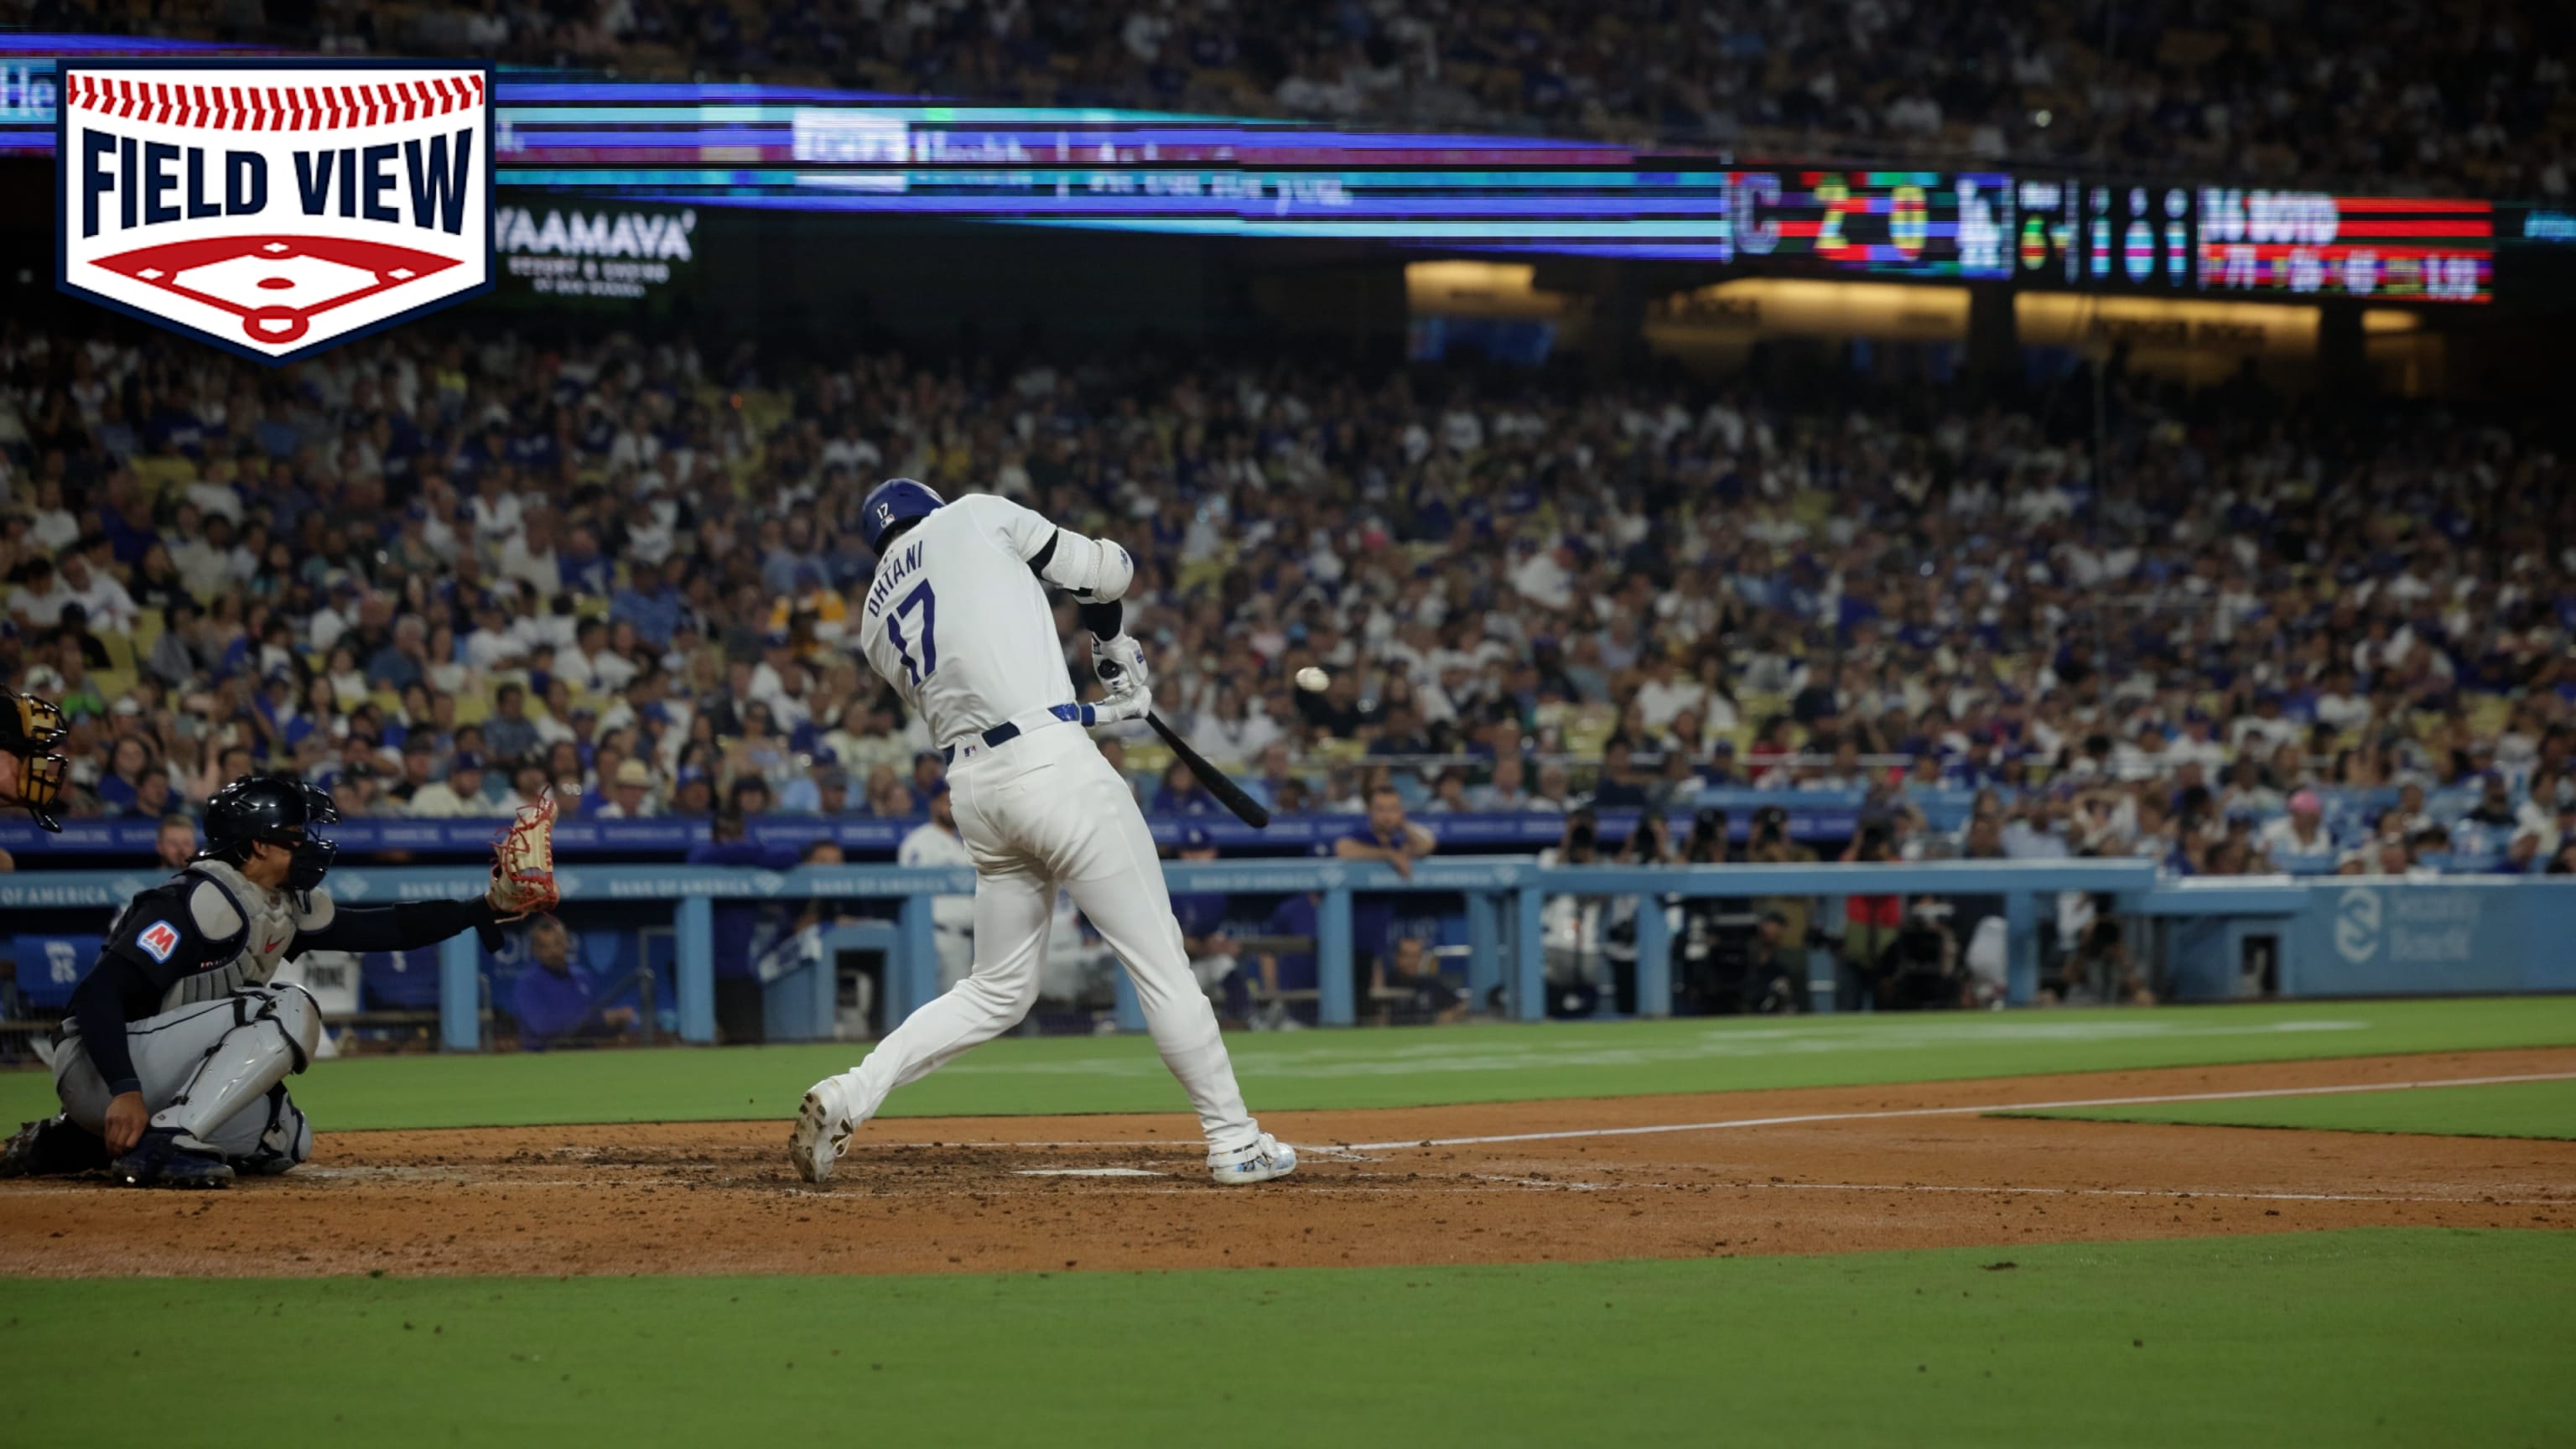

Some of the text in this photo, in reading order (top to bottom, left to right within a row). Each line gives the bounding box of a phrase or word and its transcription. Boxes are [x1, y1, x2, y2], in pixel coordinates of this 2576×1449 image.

[876, 502, 889, 520] 17
[868, 539, 923, 618] OHTANI
[886, 577, 937, 688] 17
[1, 886, 109, 906] OF AMERICA
